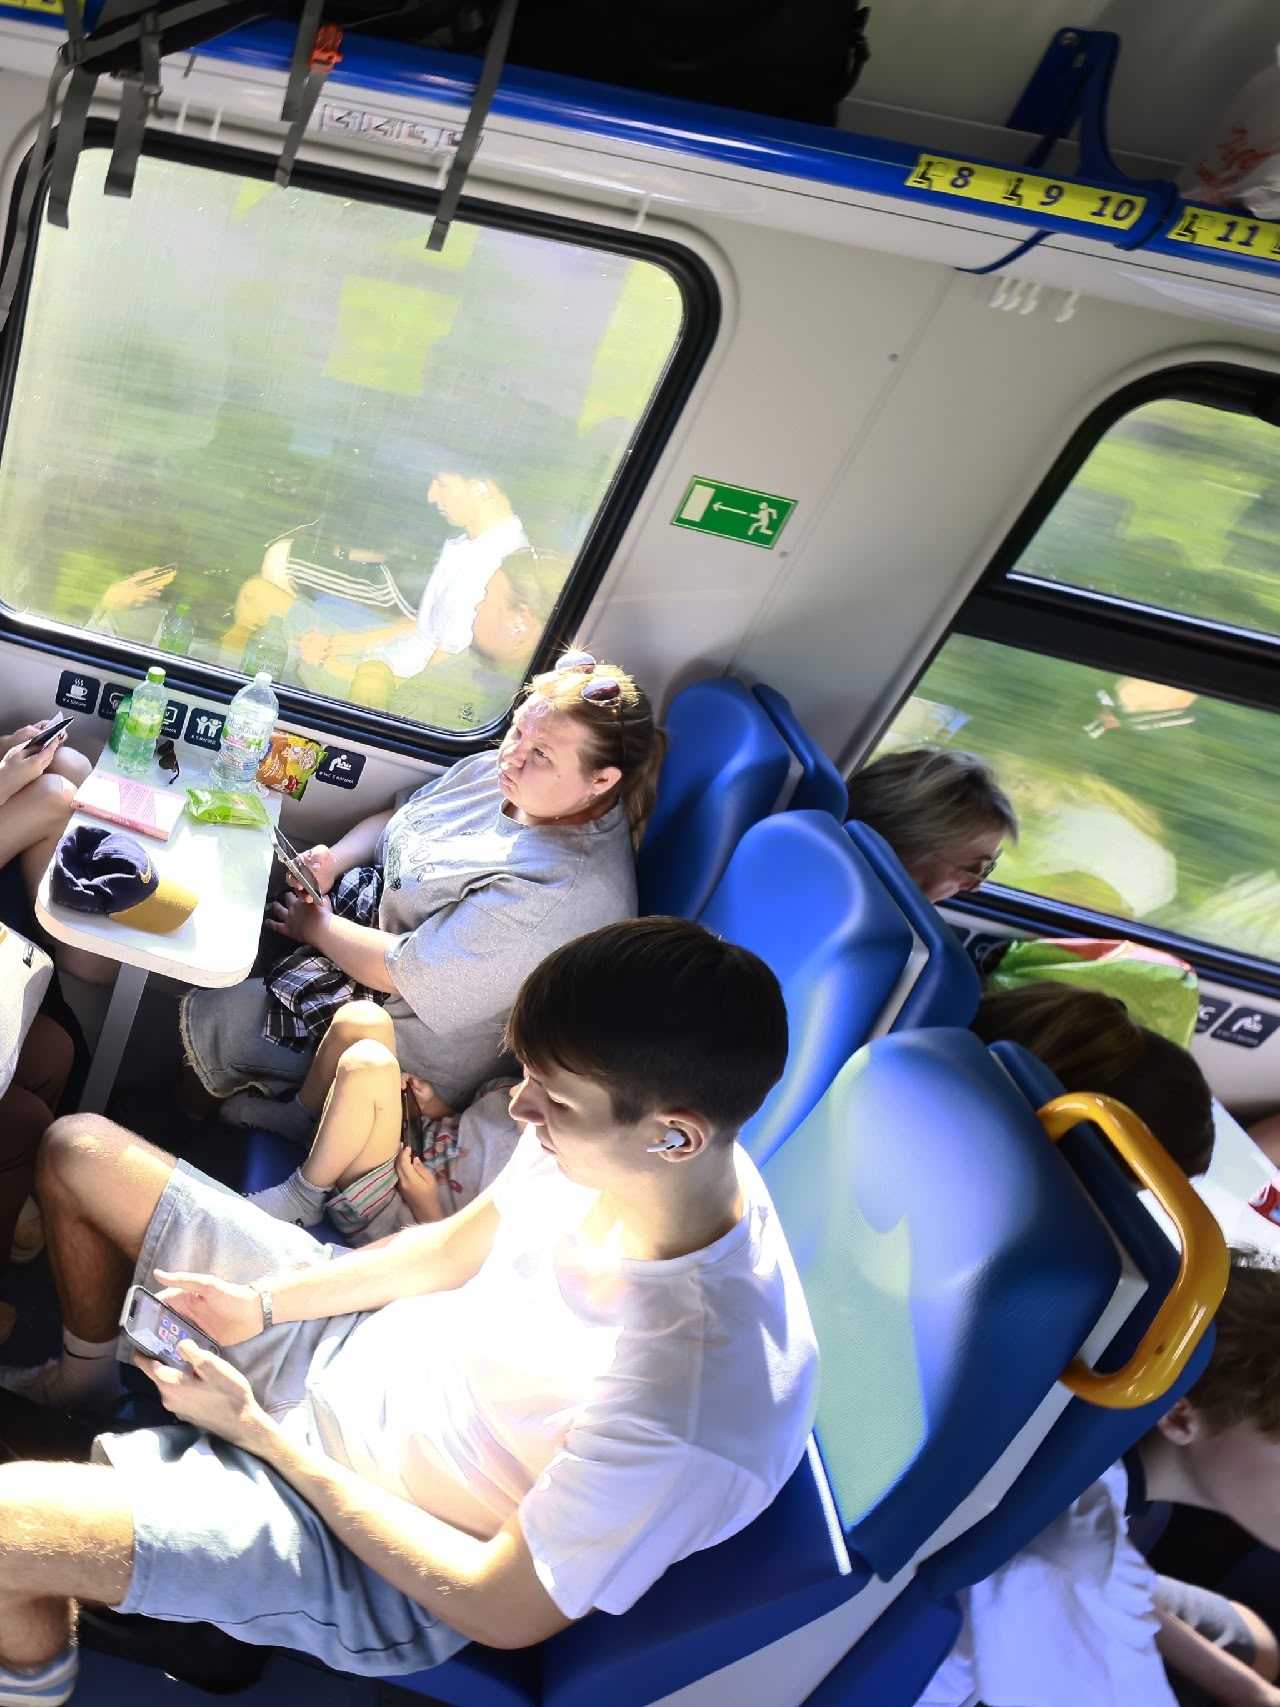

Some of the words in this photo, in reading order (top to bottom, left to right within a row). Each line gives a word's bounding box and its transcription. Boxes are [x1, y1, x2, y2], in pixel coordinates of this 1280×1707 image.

[950, 166, 975, 189] 8
[1039, 184, 1065, 207] 9
[1091, 195, 1136, 221] 10
[1215, 220, 1260, 247] 11
